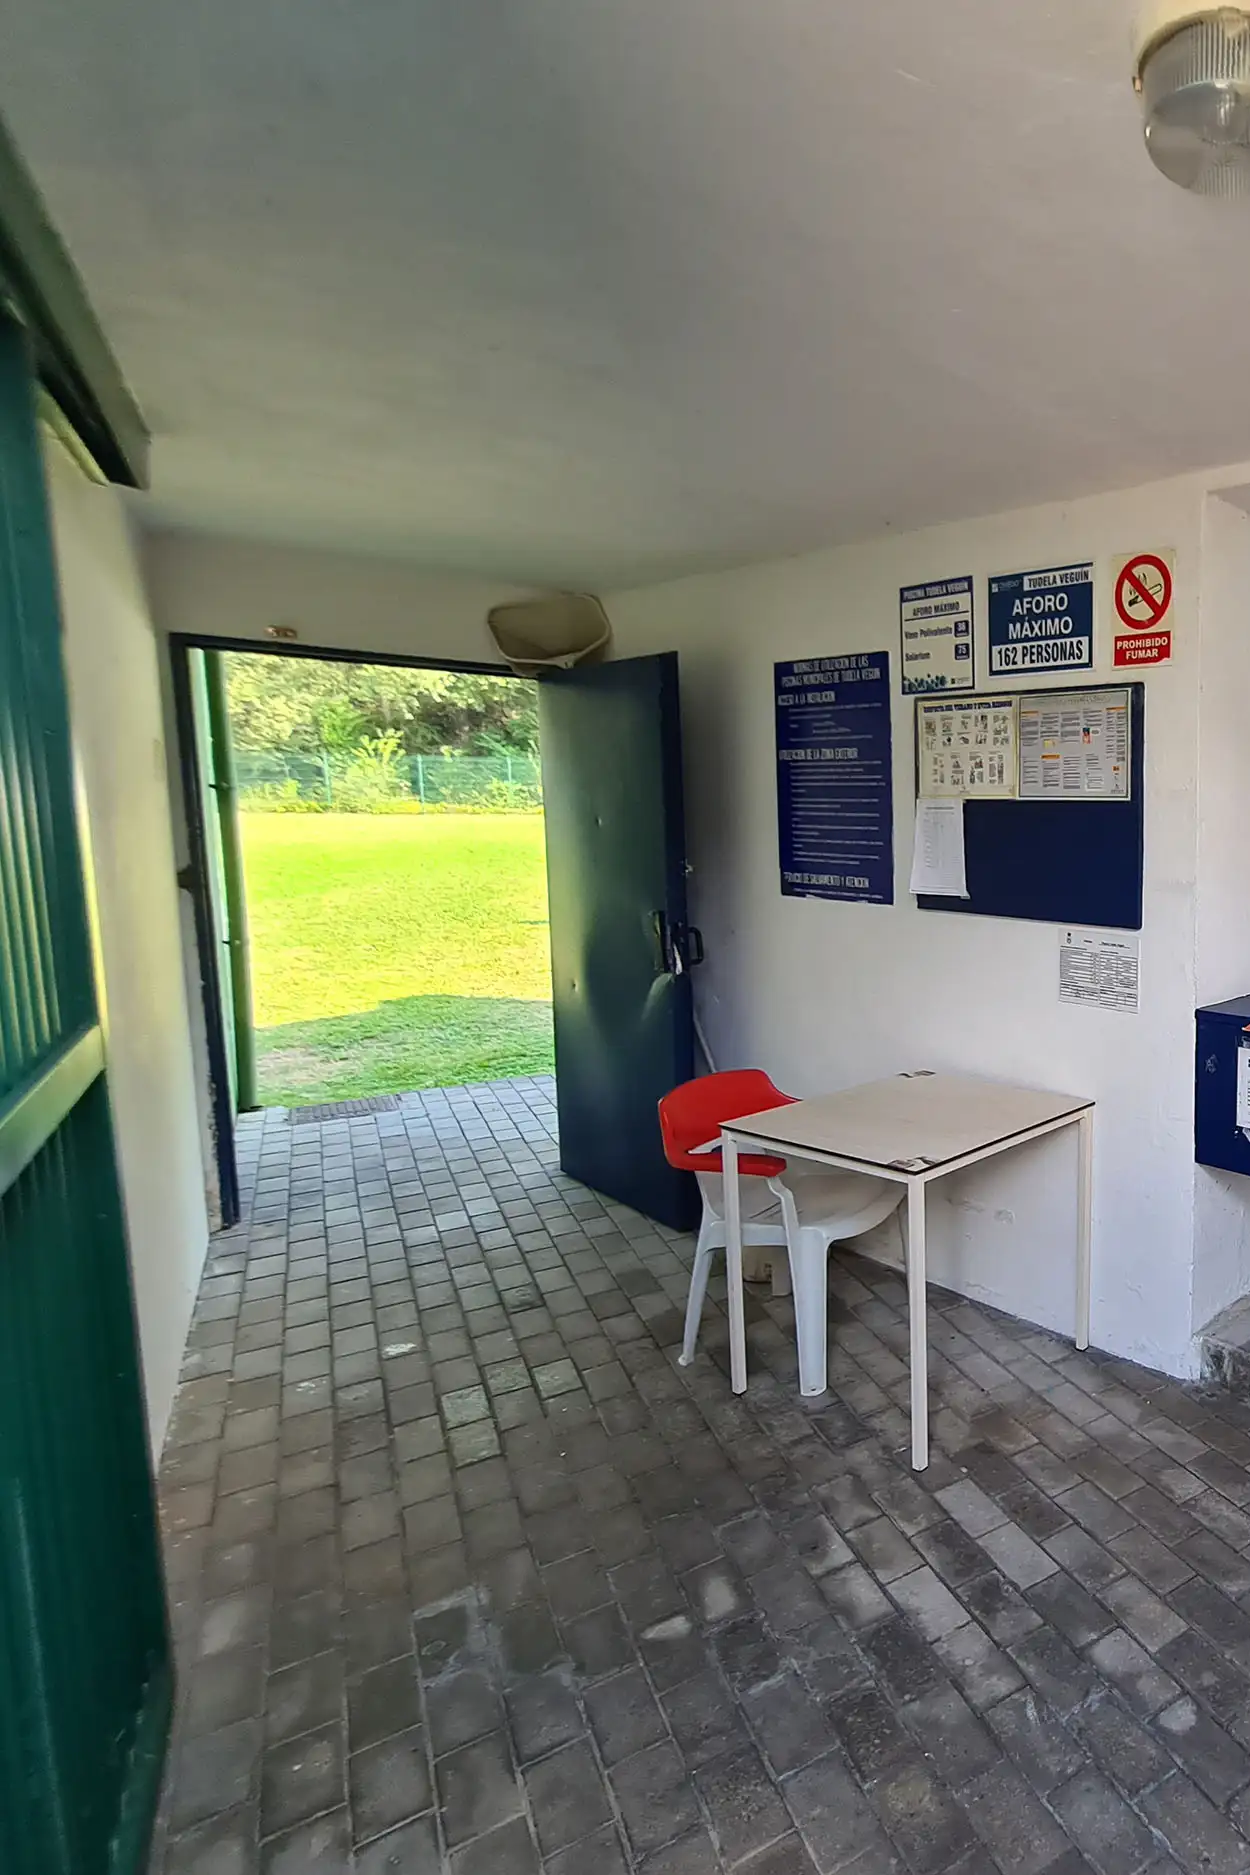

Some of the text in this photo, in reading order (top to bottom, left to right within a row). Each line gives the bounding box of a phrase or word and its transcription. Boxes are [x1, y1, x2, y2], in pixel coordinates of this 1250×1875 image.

[1028, 575, 1058, 588] TUDELA
[1059, 567, 1089, 585] VEGUÍN
[1012, 593, 1068, 616] AFORO
[1008, 616, 1073, 640] MÁXIMO
[998, 639, 1084, 667] 162 PERSONAS
[1116, 636, 1168, 650] PROHIBIDO
[1125, 648, 1159, 661] FUMAR
